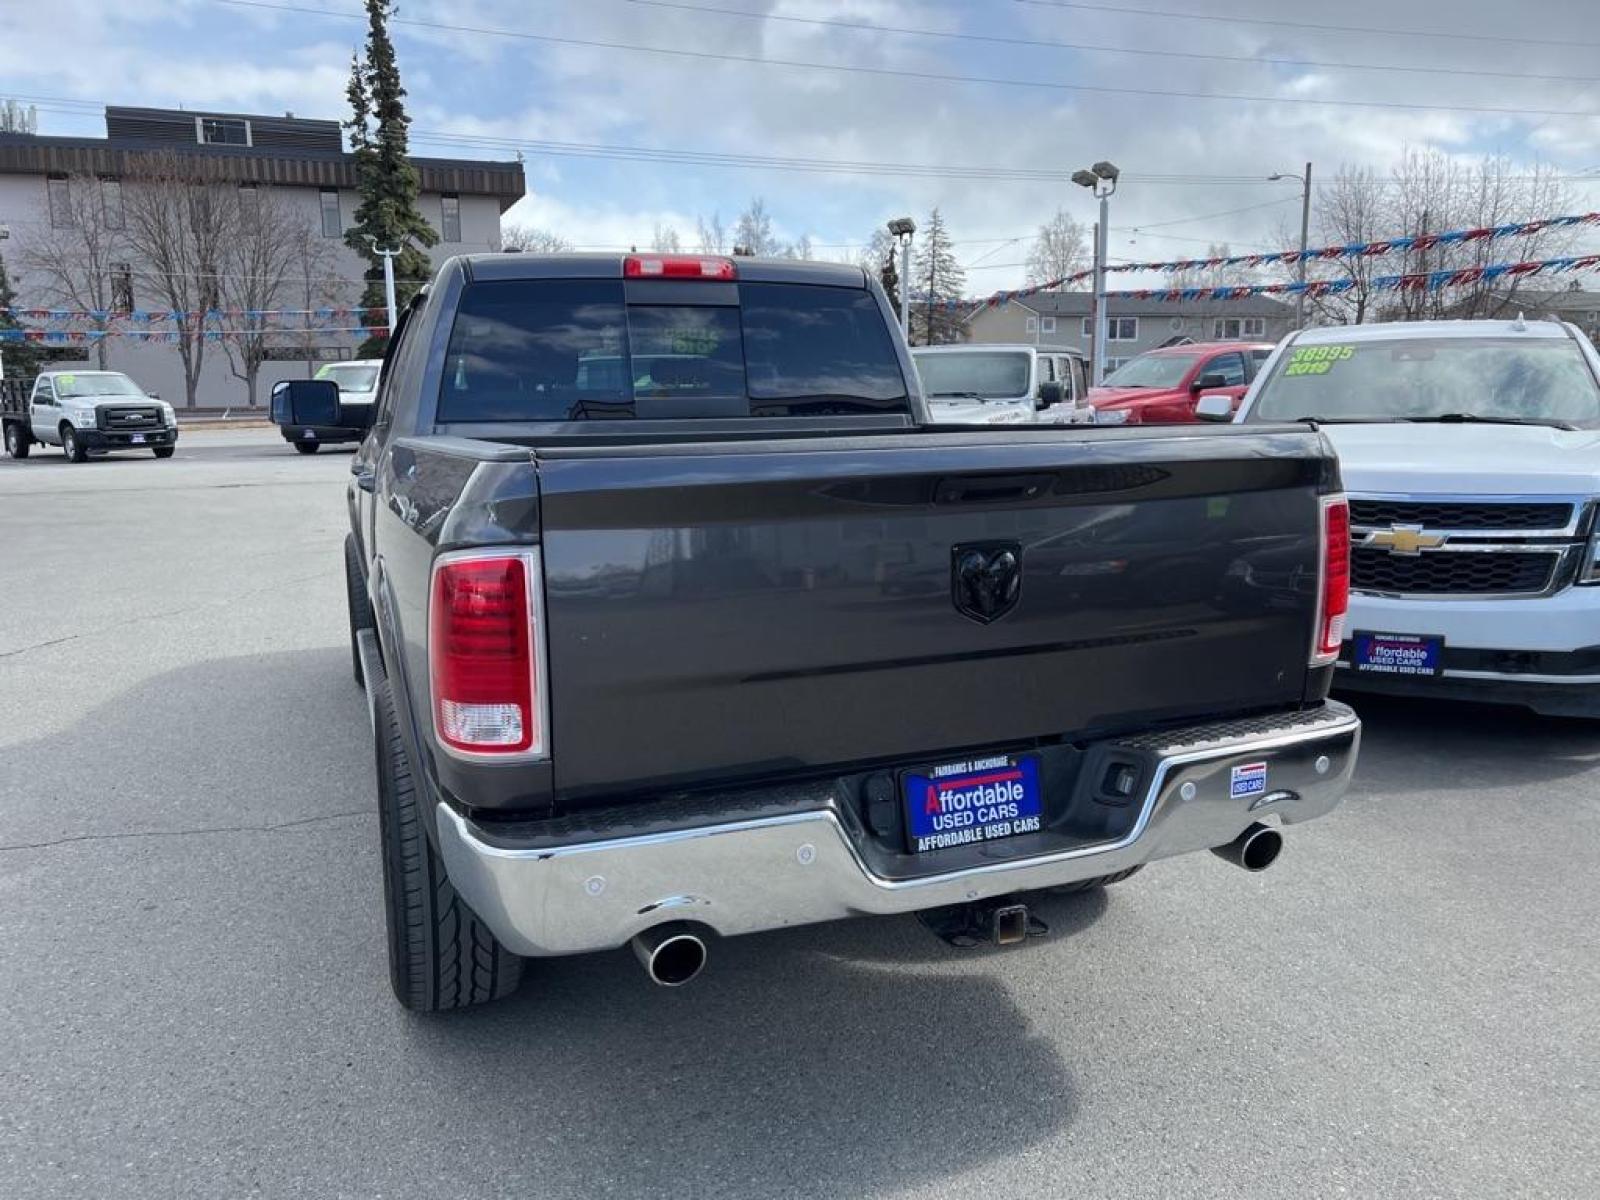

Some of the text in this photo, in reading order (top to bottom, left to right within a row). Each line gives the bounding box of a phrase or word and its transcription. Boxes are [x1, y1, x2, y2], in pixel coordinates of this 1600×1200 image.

[1367, 643, 1428, 660] Affordable
[1369, 656, 1422, 666] USED CARS
[925, 780, 1024, 815] Affordable
[932, 803, 1018, 831] USED CARS
[918, 816, 1040, 852] AFFORDABLE USED CARS
